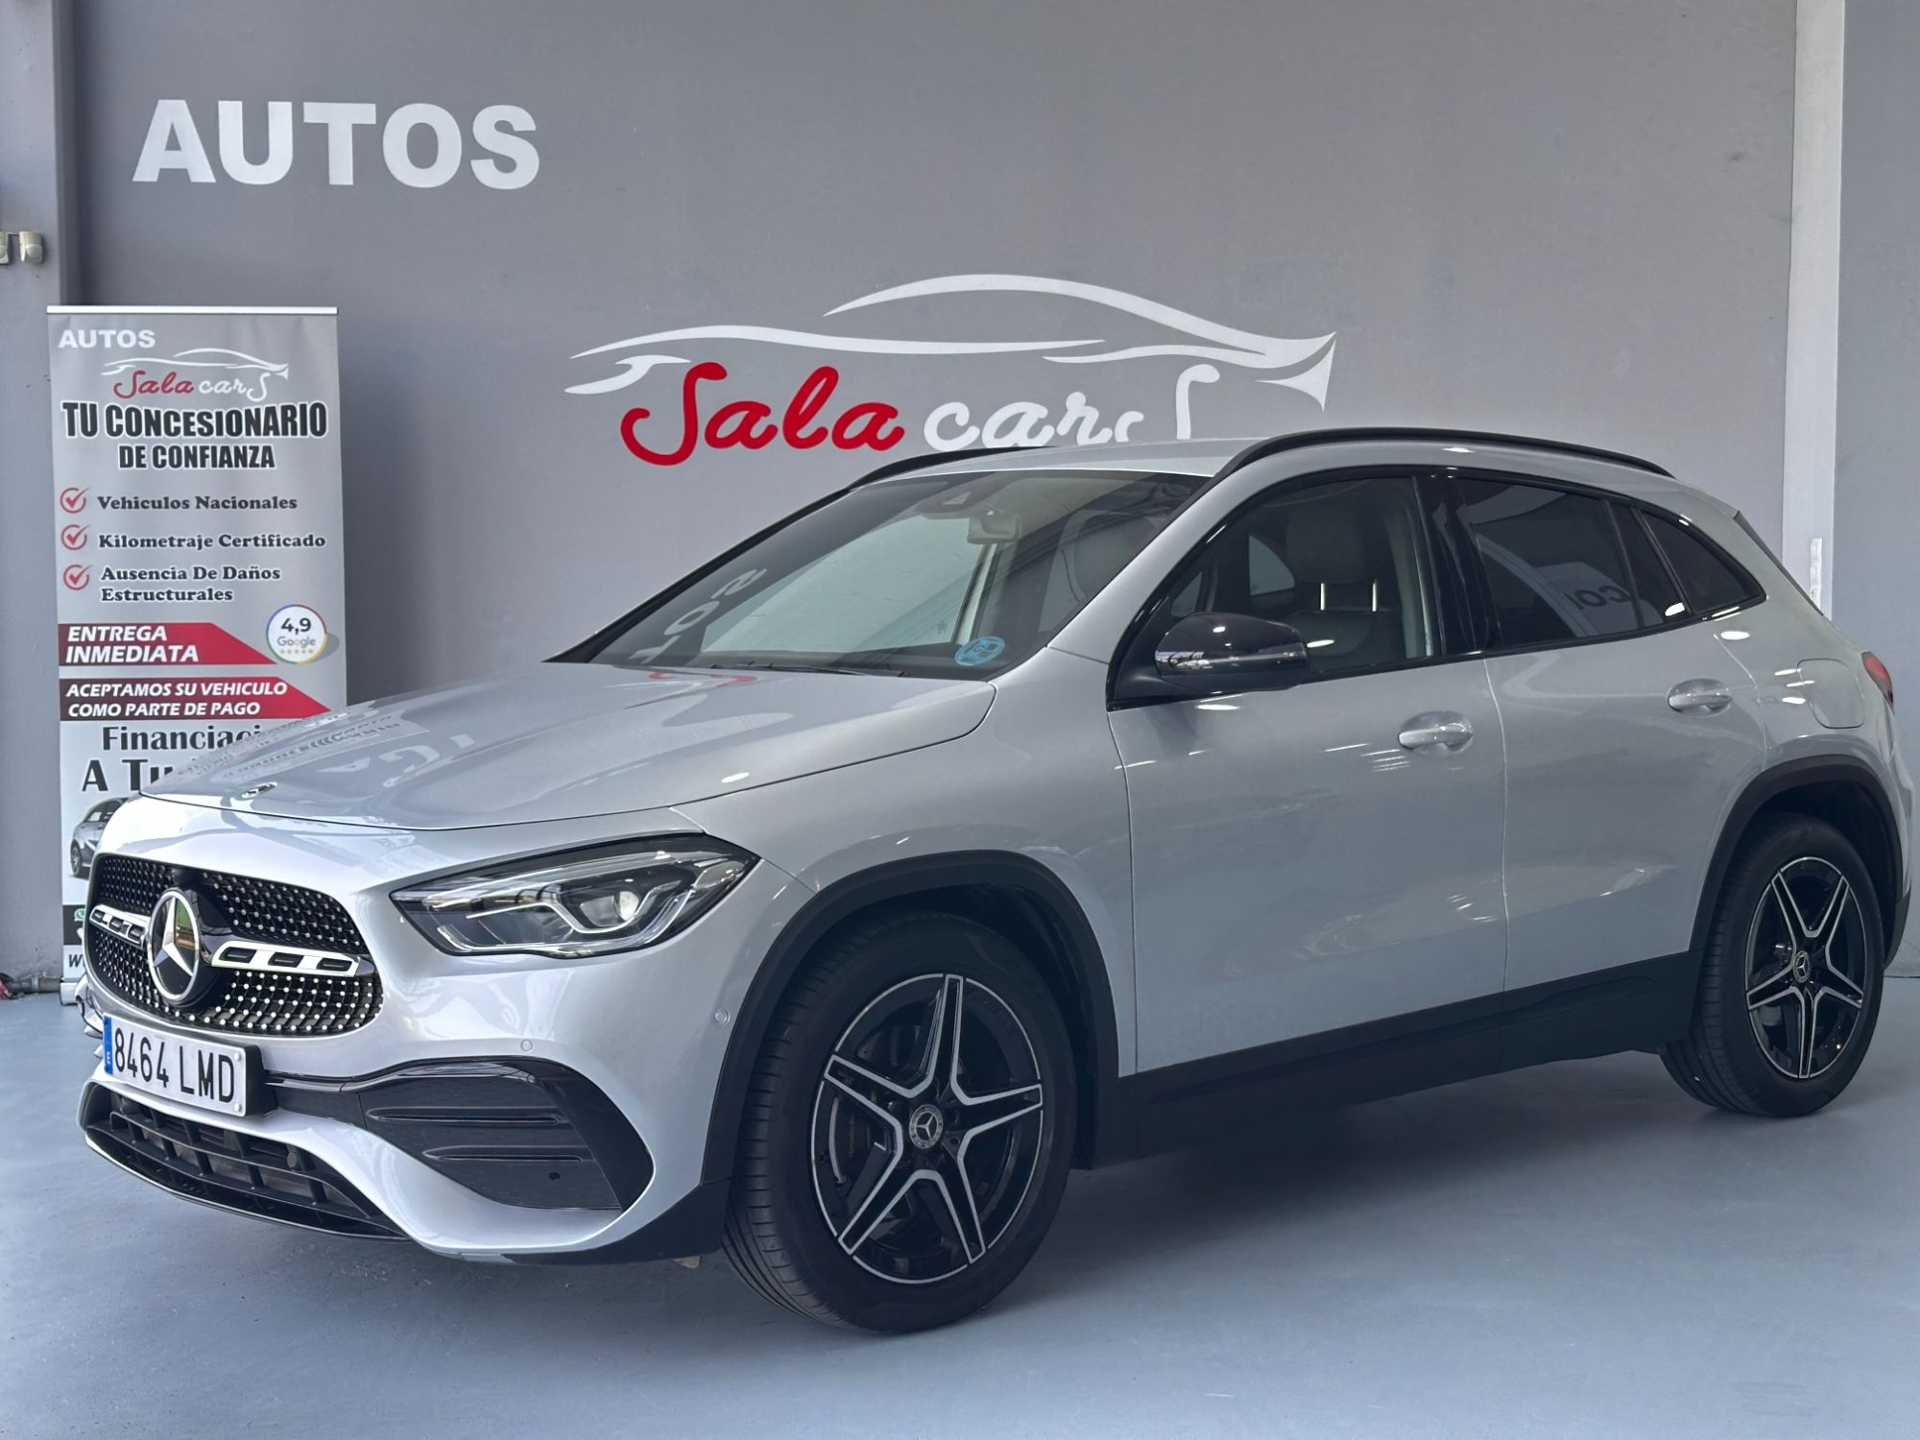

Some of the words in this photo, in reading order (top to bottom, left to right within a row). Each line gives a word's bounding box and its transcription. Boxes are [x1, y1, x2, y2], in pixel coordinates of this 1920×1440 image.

[132, 99, 540, 190] AUTOS
[58, 329, 156, 348] AUTOS
[113, 370, 194, 399] Sala
[62, 402, 98, 437] TU
[105, 402, 327, 437] CONCESIONARIO
[620, 362, 905, 466] Sala
[119, 445, 147, 468] DE
[152, 445, 275, 468] CONFIANZA
[97, 496, 190, 509] Vehiculos
[195, 496, 297, 509] Nacionales
[99, 534, 213, 550] Kilometraje
[218, 534, 326, 548] Certificado
[101, 567, 187, 580] Ausencia
[193, 567, 217, 580] De
[222, 566, 281, 580] Daños
[101, 588, 233, 602] Estructurales
[67, 626, 168, 642] ENTREGA
[281, 617, 312, 635] 4,9
[277, 636, 316, 648] Google
[66, 645, 199, 663] INMEDIATA
[66, 683, 171, 698] ACEPTAMOS
[175, 683, 197, 697] SU
[200, 682, 288, 697] VEHICULO
[68, 704, 121, 717] COMO
[125, 703, 181, 717] PARTE
[184, 703, 206, 716] DE
[211, 702, 260, 716] PAGO
[81, 759, 109, 792] A
[115, 1028, 169, 1088] 8464
[179, 1045, 235, 1104] LMD
